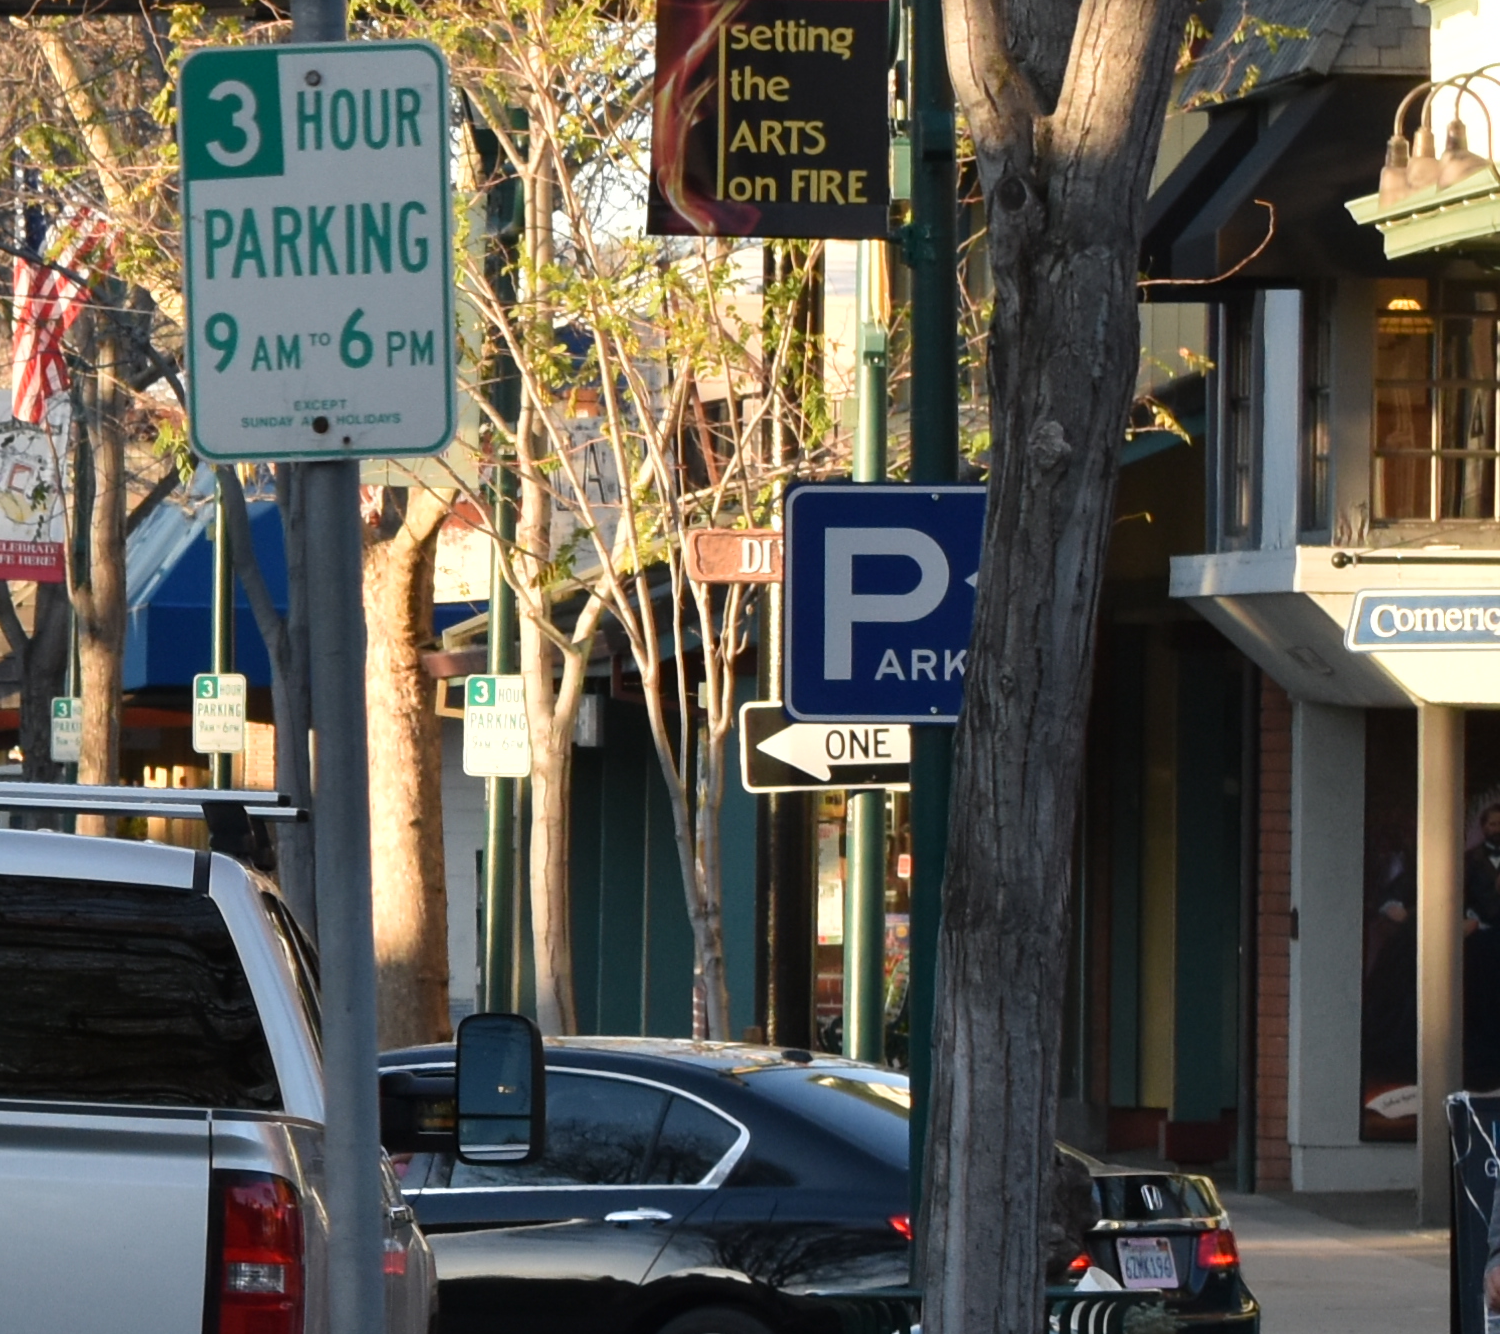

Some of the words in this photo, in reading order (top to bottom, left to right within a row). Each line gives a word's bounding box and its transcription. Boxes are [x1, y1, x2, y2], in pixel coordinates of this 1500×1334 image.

[730, 19, 854, 60] setting
[730, 66, 790, 102] the
[204, 79, 262, 167] 3
[296, 87, 423, 152] HOUR
[729, 119, 827, 156] ARTS
[728, 175, 776, 202] on
[791, 169, 869, 205] FIRE
[204, 200, 430, 280] PARKING
[308, 332, 331, 347] TO
[293, 399, 348, 412] EXCEPT
[241, 416, 295, 428] SUNDAY
[336, 413, 402, 425] HOLIDAYS
[202, 680, 213, 698] 3
[220, 684, 243, 697] HOUR
[474, 680, 489, 704] 3
[58, 702, 68, 717] 3
[198, 703, 242, 717] PARKING
[55, 721, 81, 733] PARKI
[470, 712, 527, 731] PARKING
[825, 728, 892, 761] ONE
